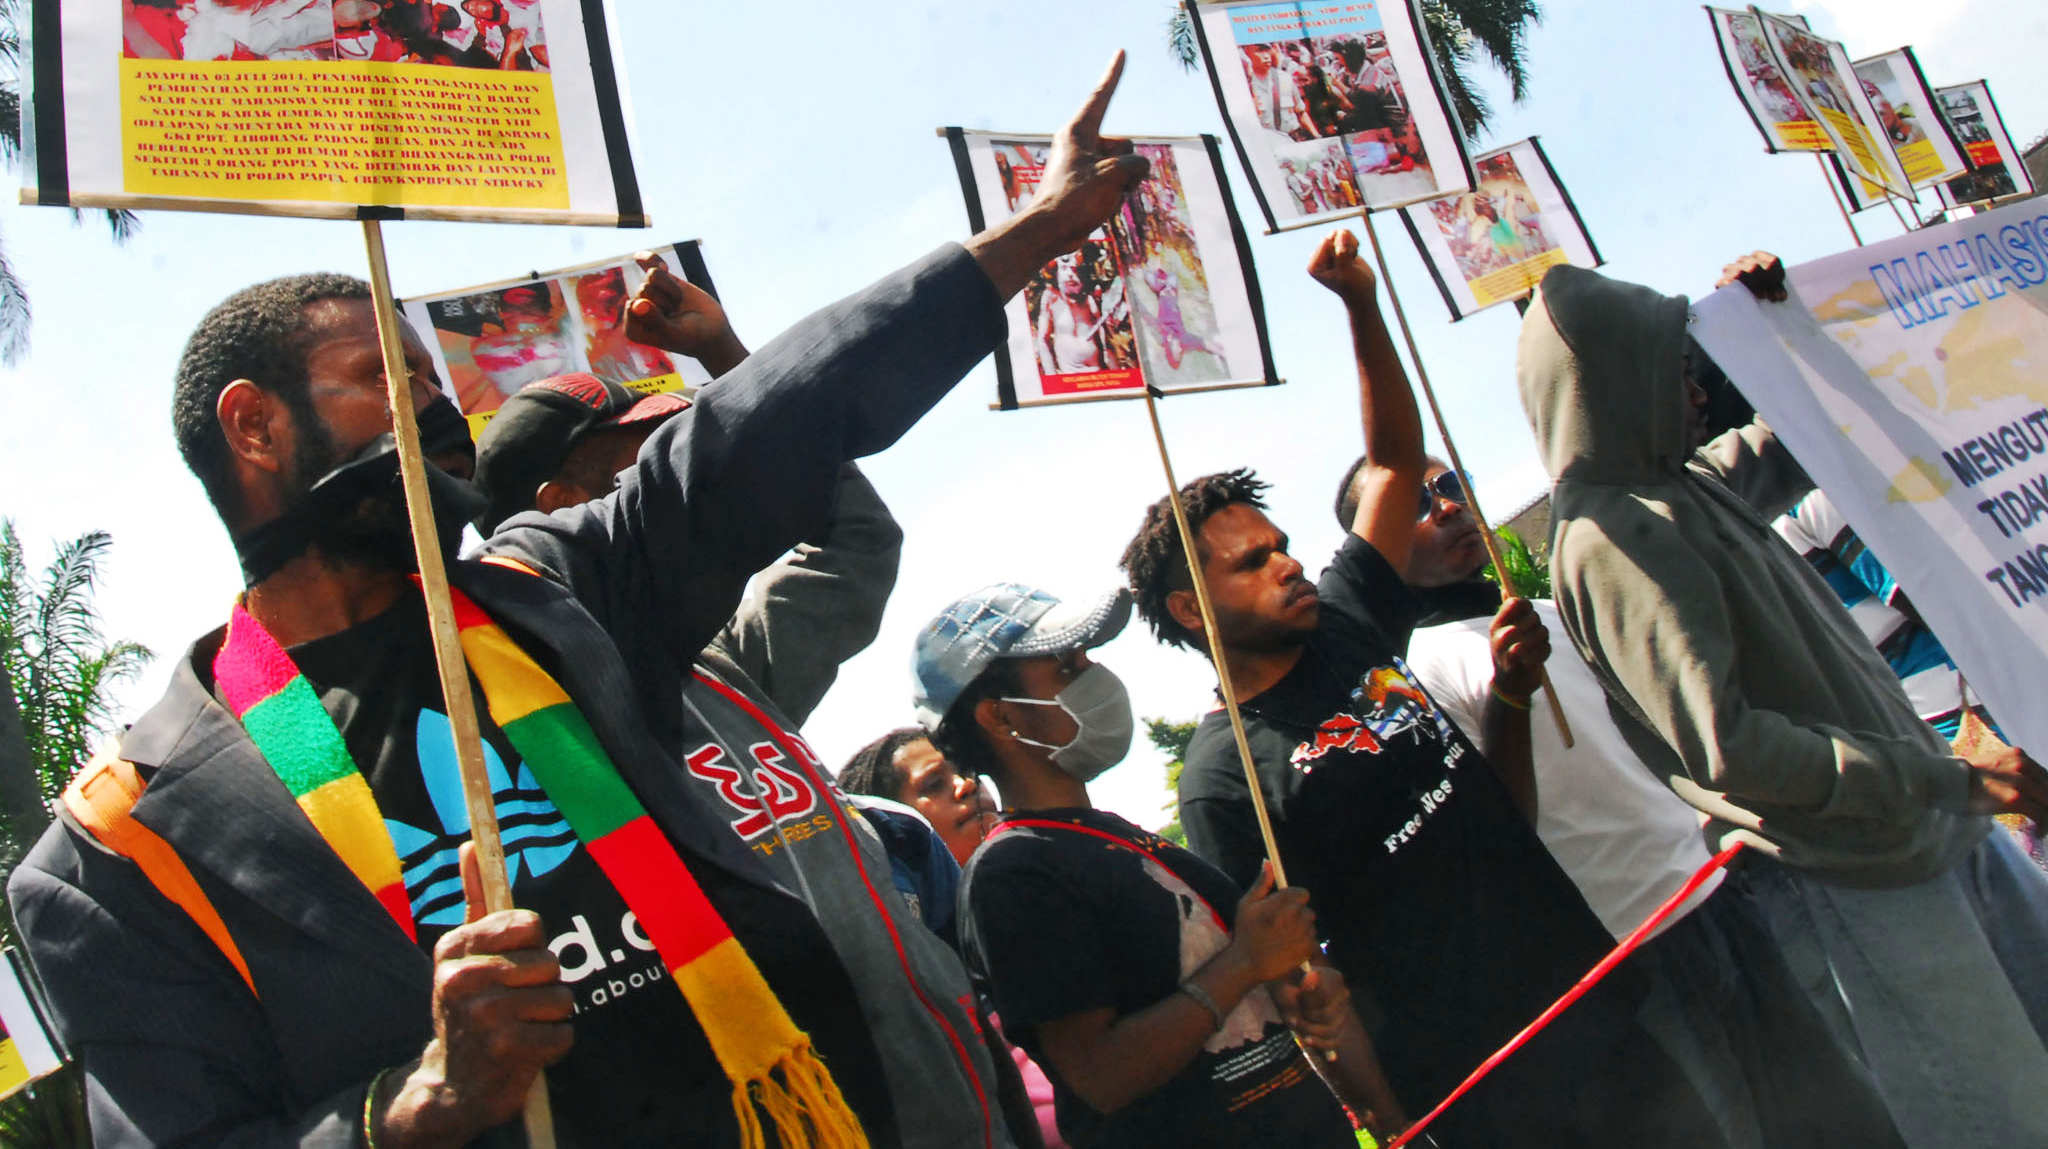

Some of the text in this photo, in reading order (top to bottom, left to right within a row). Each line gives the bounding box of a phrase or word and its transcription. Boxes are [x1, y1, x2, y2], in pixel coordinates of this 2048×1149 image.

[134, 71, 209, 82] JAYAPURA
[214, 73, 231, 82] 03
[235, 73, 268, 82] JULI
[312, 73, 410, 85] PENEMBAKAN
[414, 77, 509, 92] PENGANIYAAN
[513, 84, 540, 94] DAN
[147, 83, 530, 104] PEMBUNUHAN TERUS TERJADI DI TANAH PAPUA BARAT
[139, 94, 541, 116] SALAH SATU MAHASISWA STIE UMEL MANDIRI ATAS NAMA
[133, 118, 551, 140] (DELAPAN) SEMENTARA MAYAT DISEMAYAMKAN DI ASRAMA
[277, 109, 338, 119] (EMEKA)
[343, 109, 426, 121] MAHASISWA
[430, 114, 501, 126] SEMESTER
[505, 118, 532, 127] VIII
[163, 132, 191, 142] GKI
[195, 133, 228, 143] PDT.
[313, 133, 369, 145] PADANG
[374, 136, 424, 147] BULAN.
[428, 138, 456, 148] DAN
[460, 139, 496, 149] JUGA
[499, 141, 527, 151] ADA
[137, 142, 552, 164] BEBERAPA MAYAT DI RUMAH SAKIT BHAYANGKARA POLRI
[133, 154, 557, 176] SEKITAR 3 ORANG PAPUA YANG DITEMBAK DAN LAINNYA DI
[149, 167, 220, 180] TAHANAN
[225, 172, 242, 181] DI
[246, 172, 295, 181] POLDA
[300, 172, 348, 184] PAPUA.
[1383, 812, 1423, 854] Free
